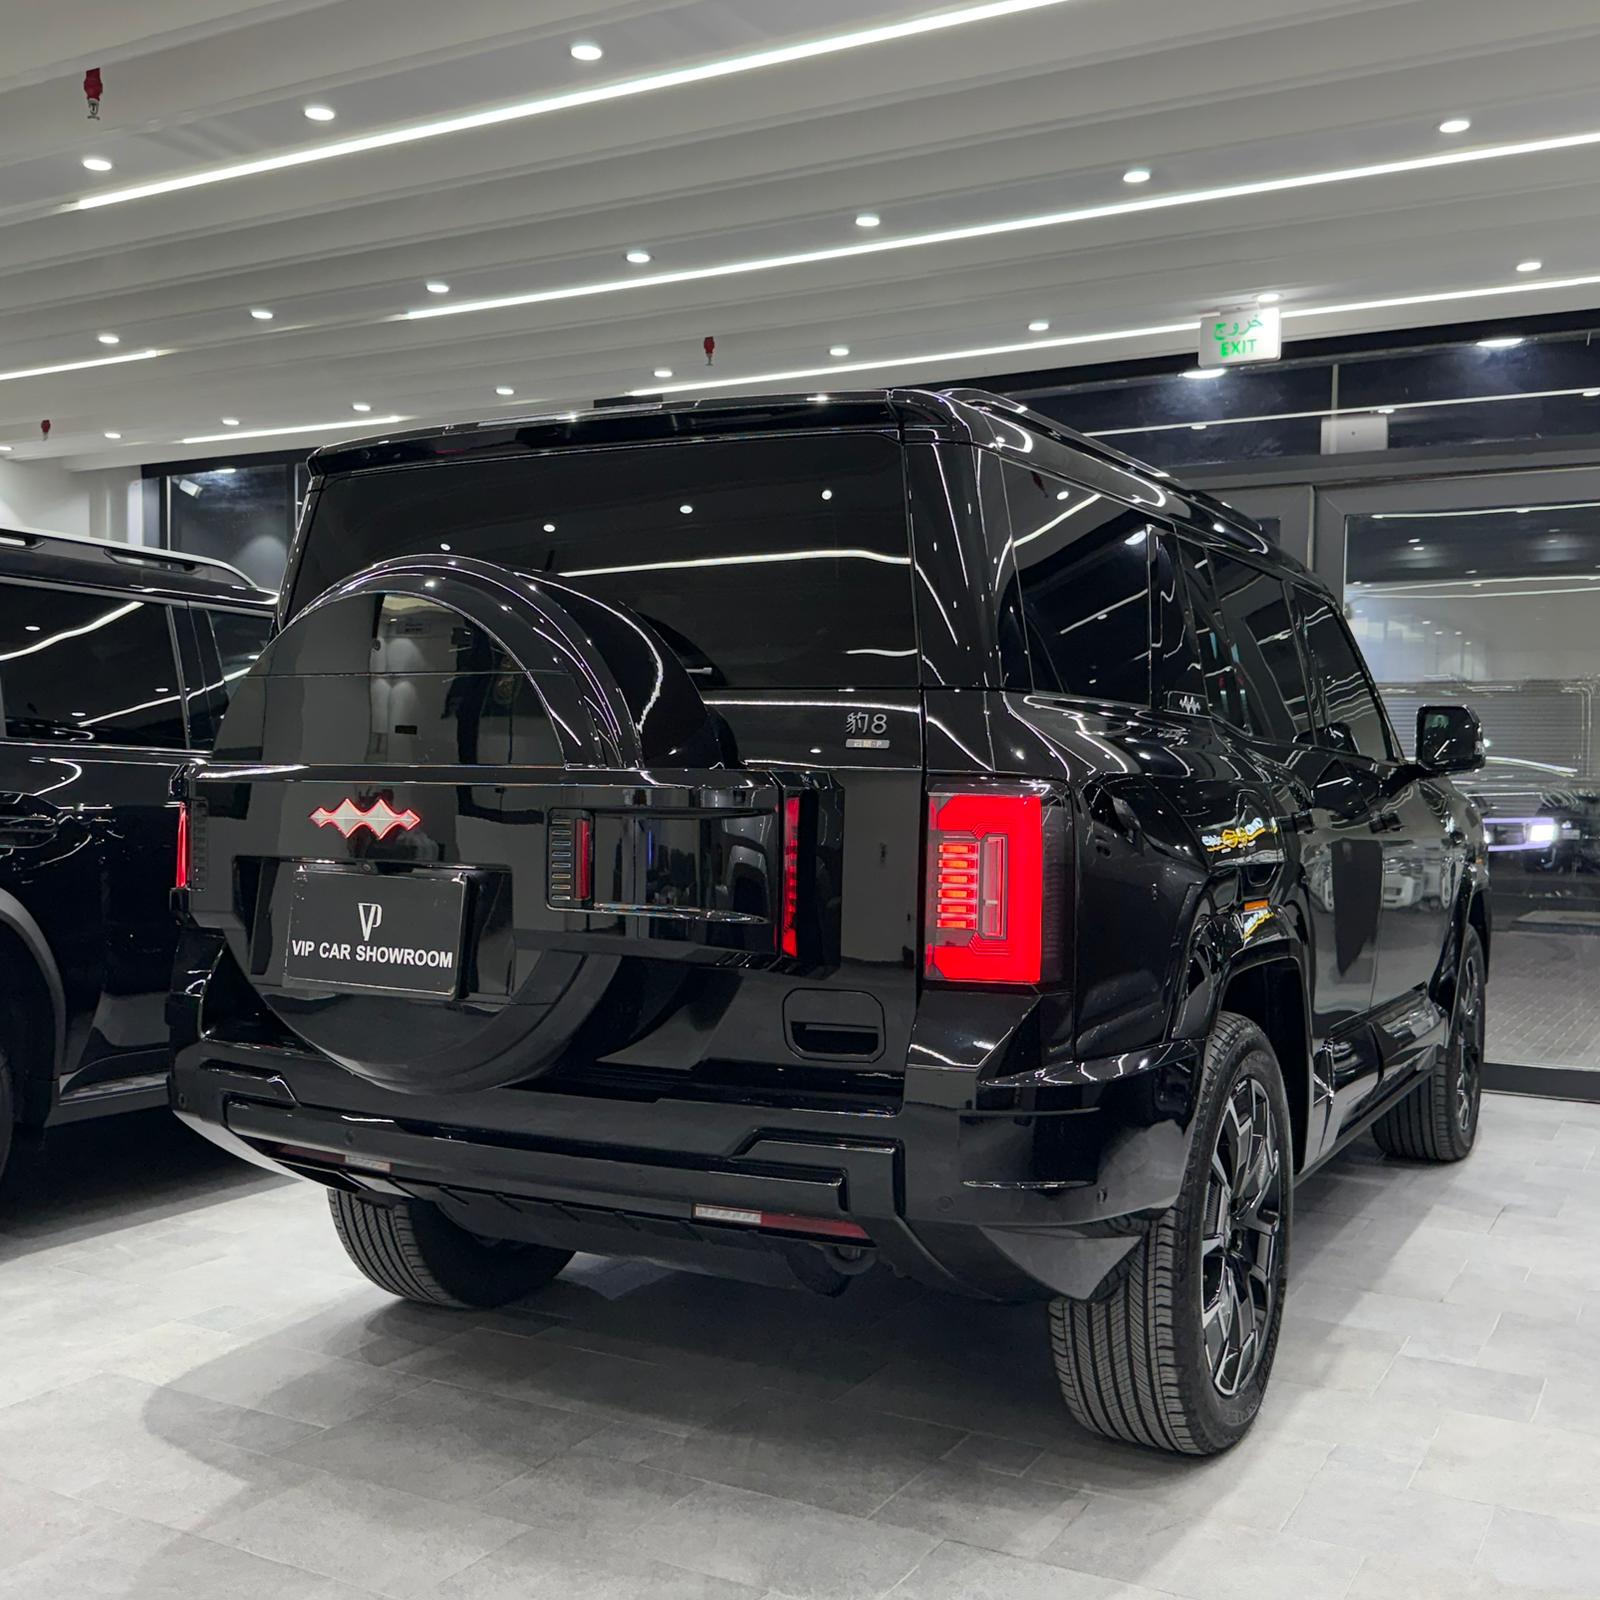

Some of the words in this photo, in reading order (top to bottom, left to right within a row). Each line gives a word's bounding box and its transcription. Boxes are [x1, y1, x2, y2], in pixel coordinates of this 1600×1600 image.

[1214, 314, 1263, 341] خروج
[1221, 339, 1257, 357] EXIT
[292, 940, 315, 957] VIP
[319, 942, 351, 960] CAR
[355, 945, 453, 968] SHOWROOM
